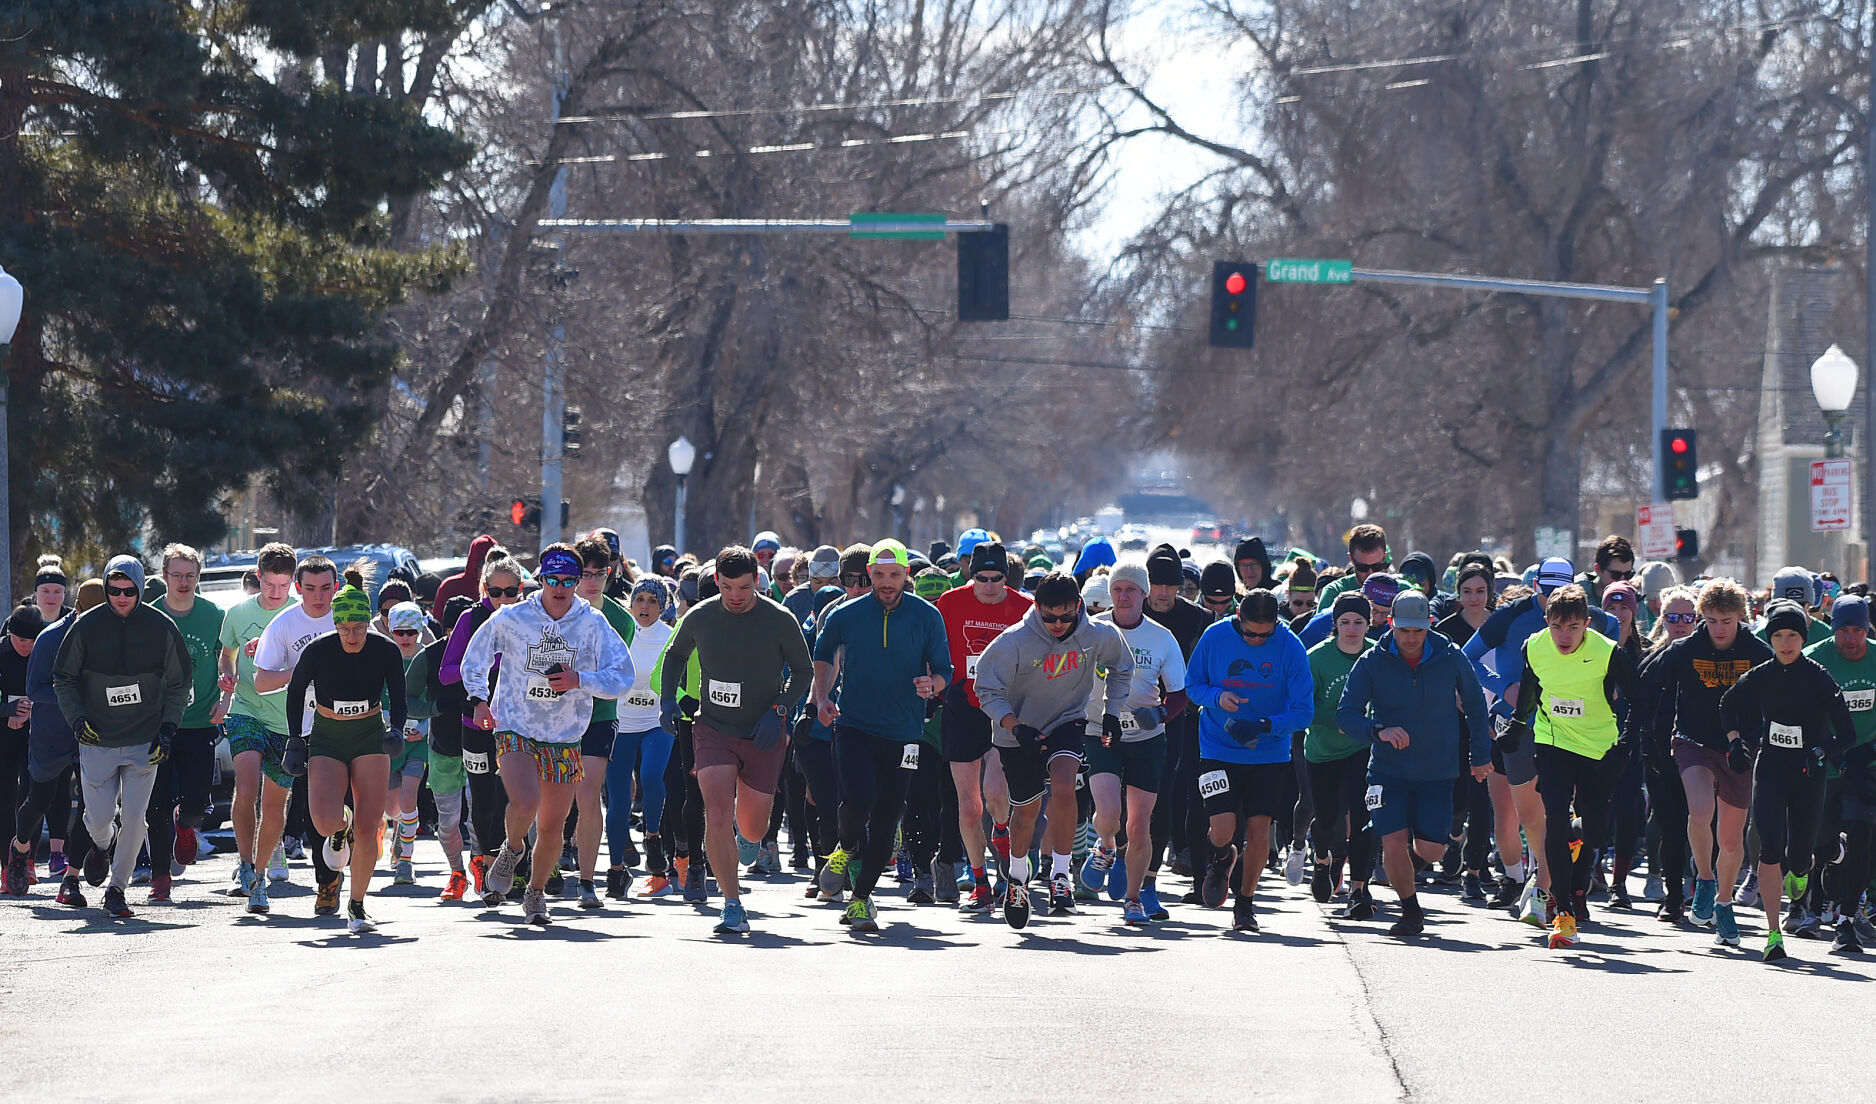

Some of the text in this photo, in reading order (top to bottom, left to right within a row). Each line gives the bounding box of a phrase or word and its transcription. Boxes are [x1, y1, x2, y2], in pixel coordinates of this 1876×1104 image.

[1270, 260, 1349, 282] Grand Ave
[1812, 466, 1824, 480] NO
[1821, 498, 1840, 507] STOP
[186, 634, 201, 642] RUN
[1043, 651, 1078, 673] NXR
[529, 687, 559, 698] 4539
[711, 691, 738, 703] 4567
[110, 693, 138, 704] 4651
[628, 697, 655, 706] 4554
[337, 705, 365, 715] 4591
[1553, 705, 1581, 715] 4571
[1771, 733, 1798, 745] 4661
[1201, 778, 1228, 796] 4500
